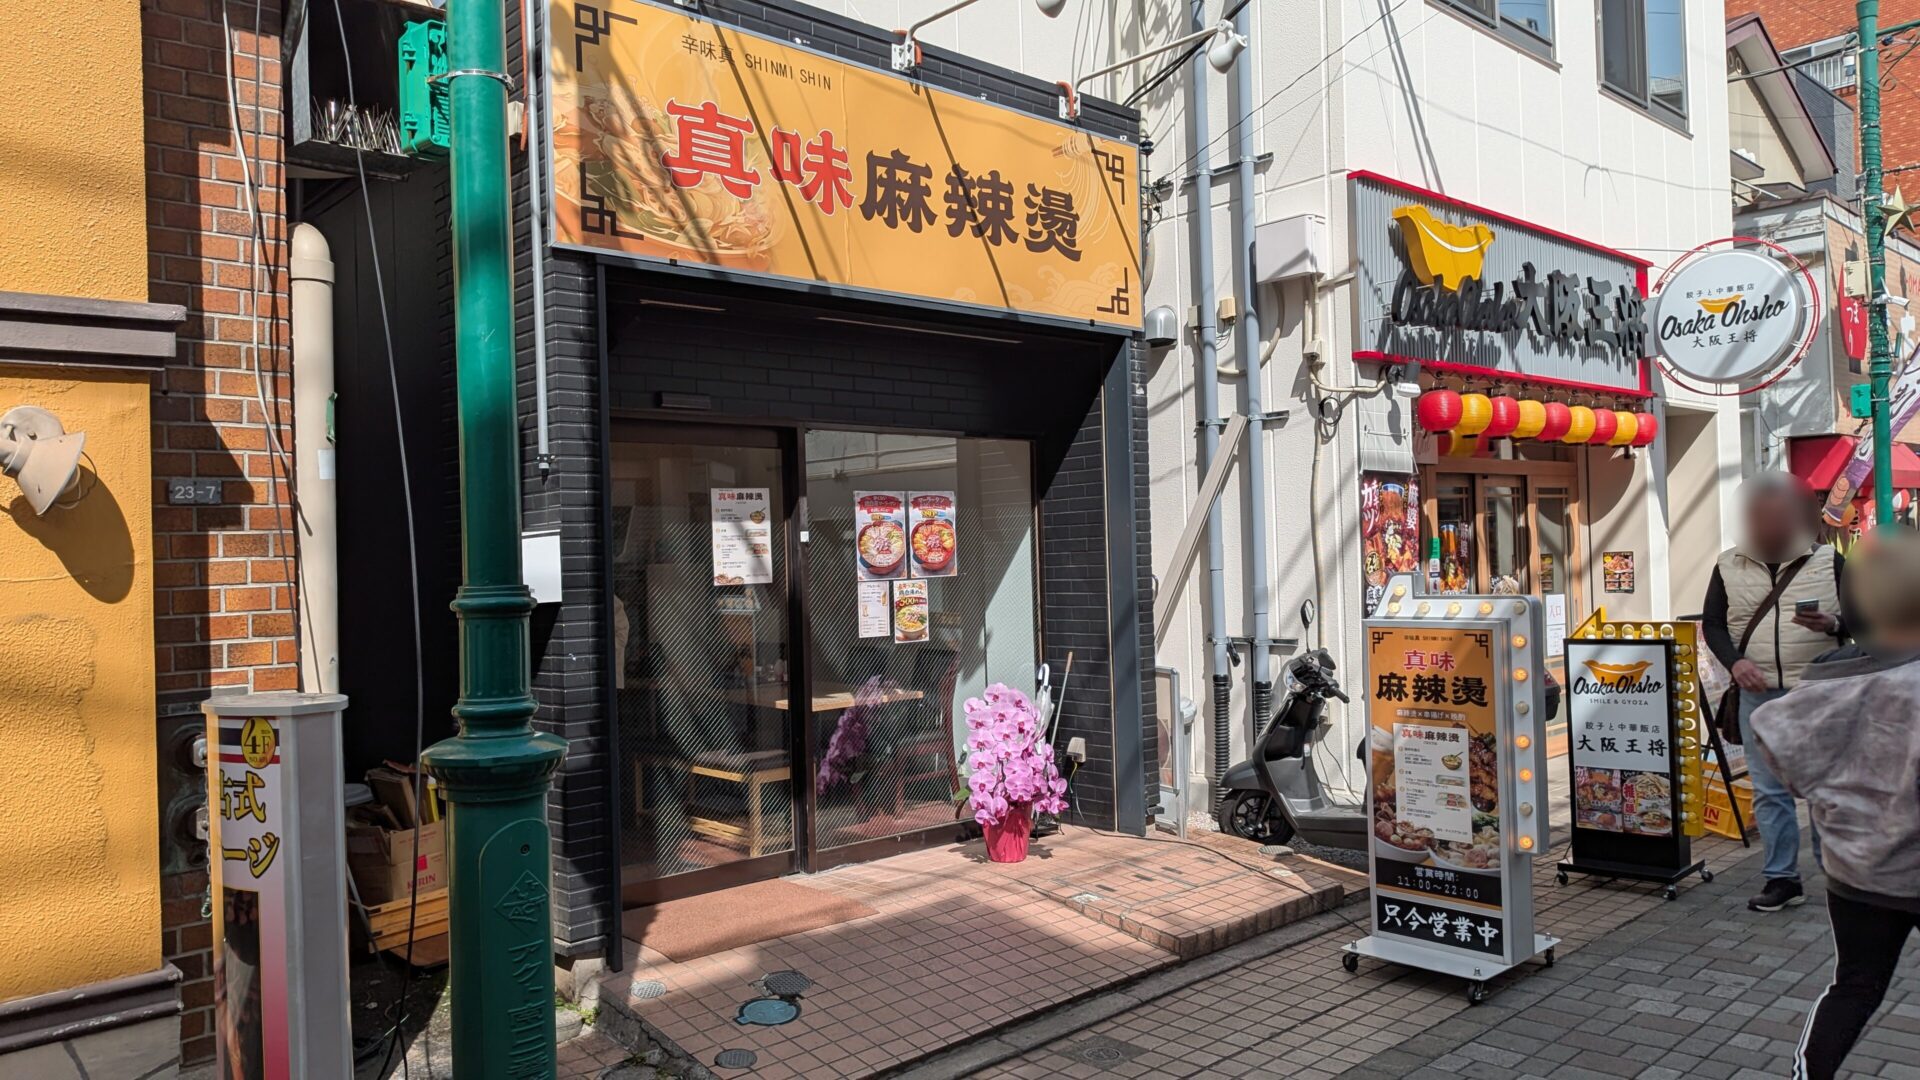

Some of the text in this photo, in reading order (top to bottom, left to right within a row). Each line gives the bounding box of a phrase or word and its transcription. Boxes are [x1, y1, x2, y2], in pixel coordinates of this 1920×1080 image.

[681, 34, 831, 90] 辛味真 SHINMI SHIN
[1661, 294, 1790, 340] Osaka Ohsho
[1692, 329, 1758, 348] 大阪王将
[174, 486, 216, 500] 23-7
[1403, 650, 1455, 671] 真味
[1573, 675, 1664, 696] Osaka Ohsho
[244, 719, 272, 754] 4F
[1576, 735, 1669, 757] 大阪王将
[1383, 904, 1499, 947] 只今営業中
